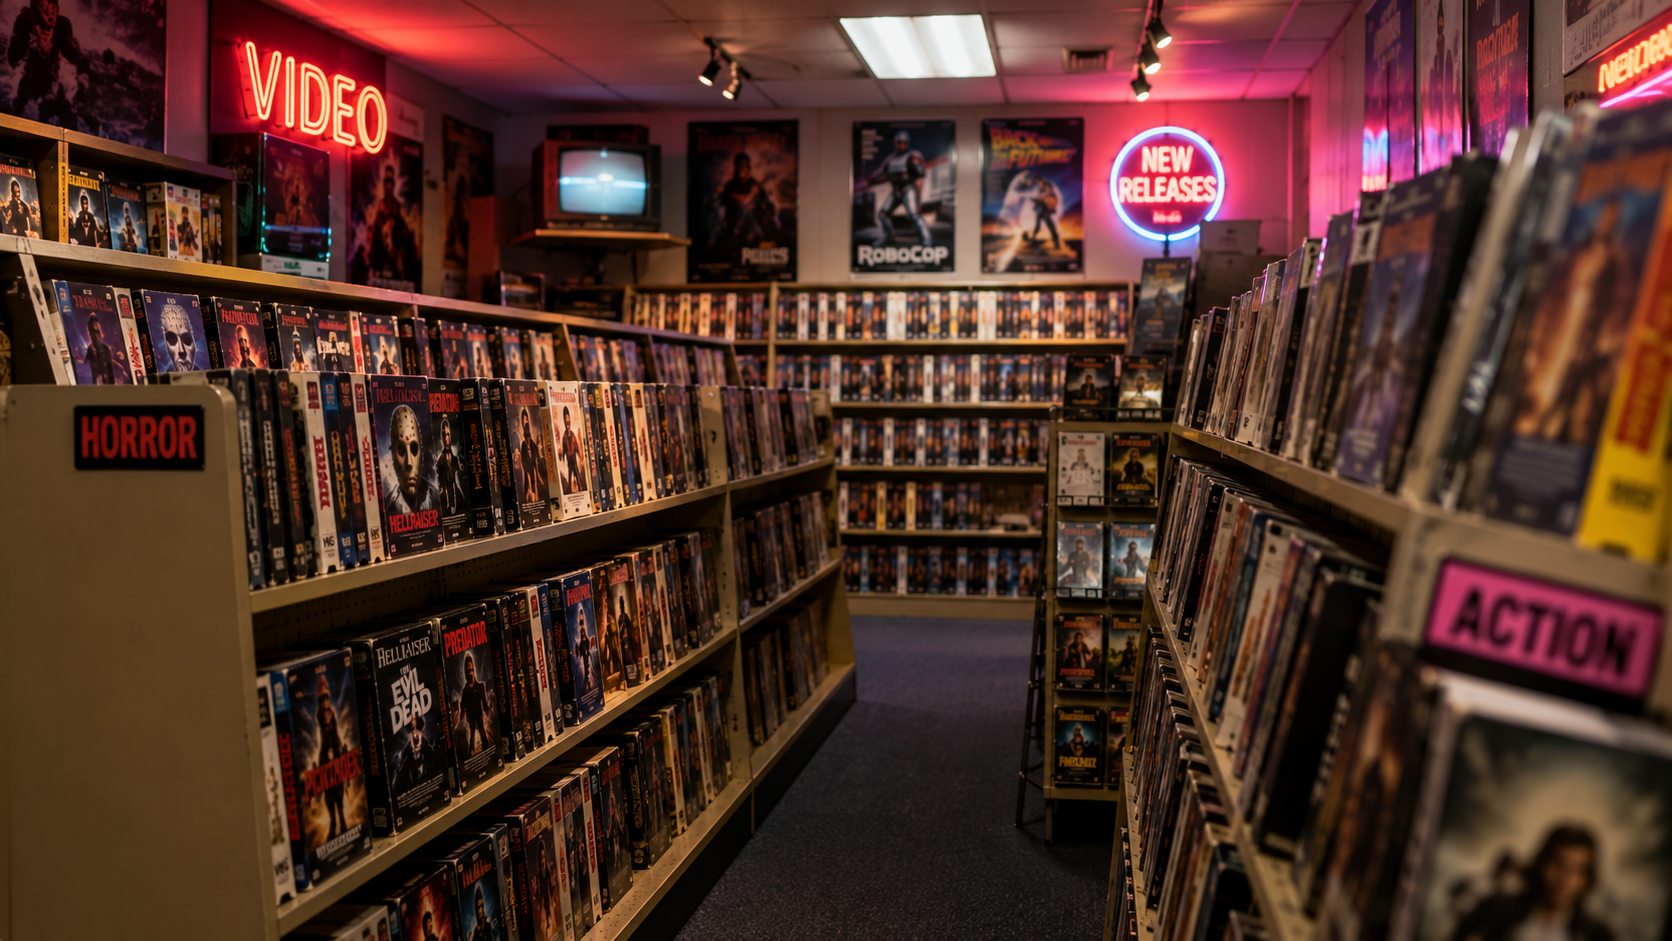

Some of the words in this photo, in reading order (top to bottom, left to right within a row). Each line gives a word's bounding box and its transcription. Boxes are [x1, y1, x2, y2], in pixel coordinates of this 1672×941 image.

[244, 41, 389, 155] VIDEO
[1142, 145, 1194, 174] NEW
[1119, 175, 1217, 204] RELEASES
[81, 415, 197, 459] HORROR
[444, 620, 488, 657] PREDATOR
[1450, 585, 1637, 678] ACTION
[391, 666, 425, 705] EVIL
[389, 688, 432, 735] DEAD
